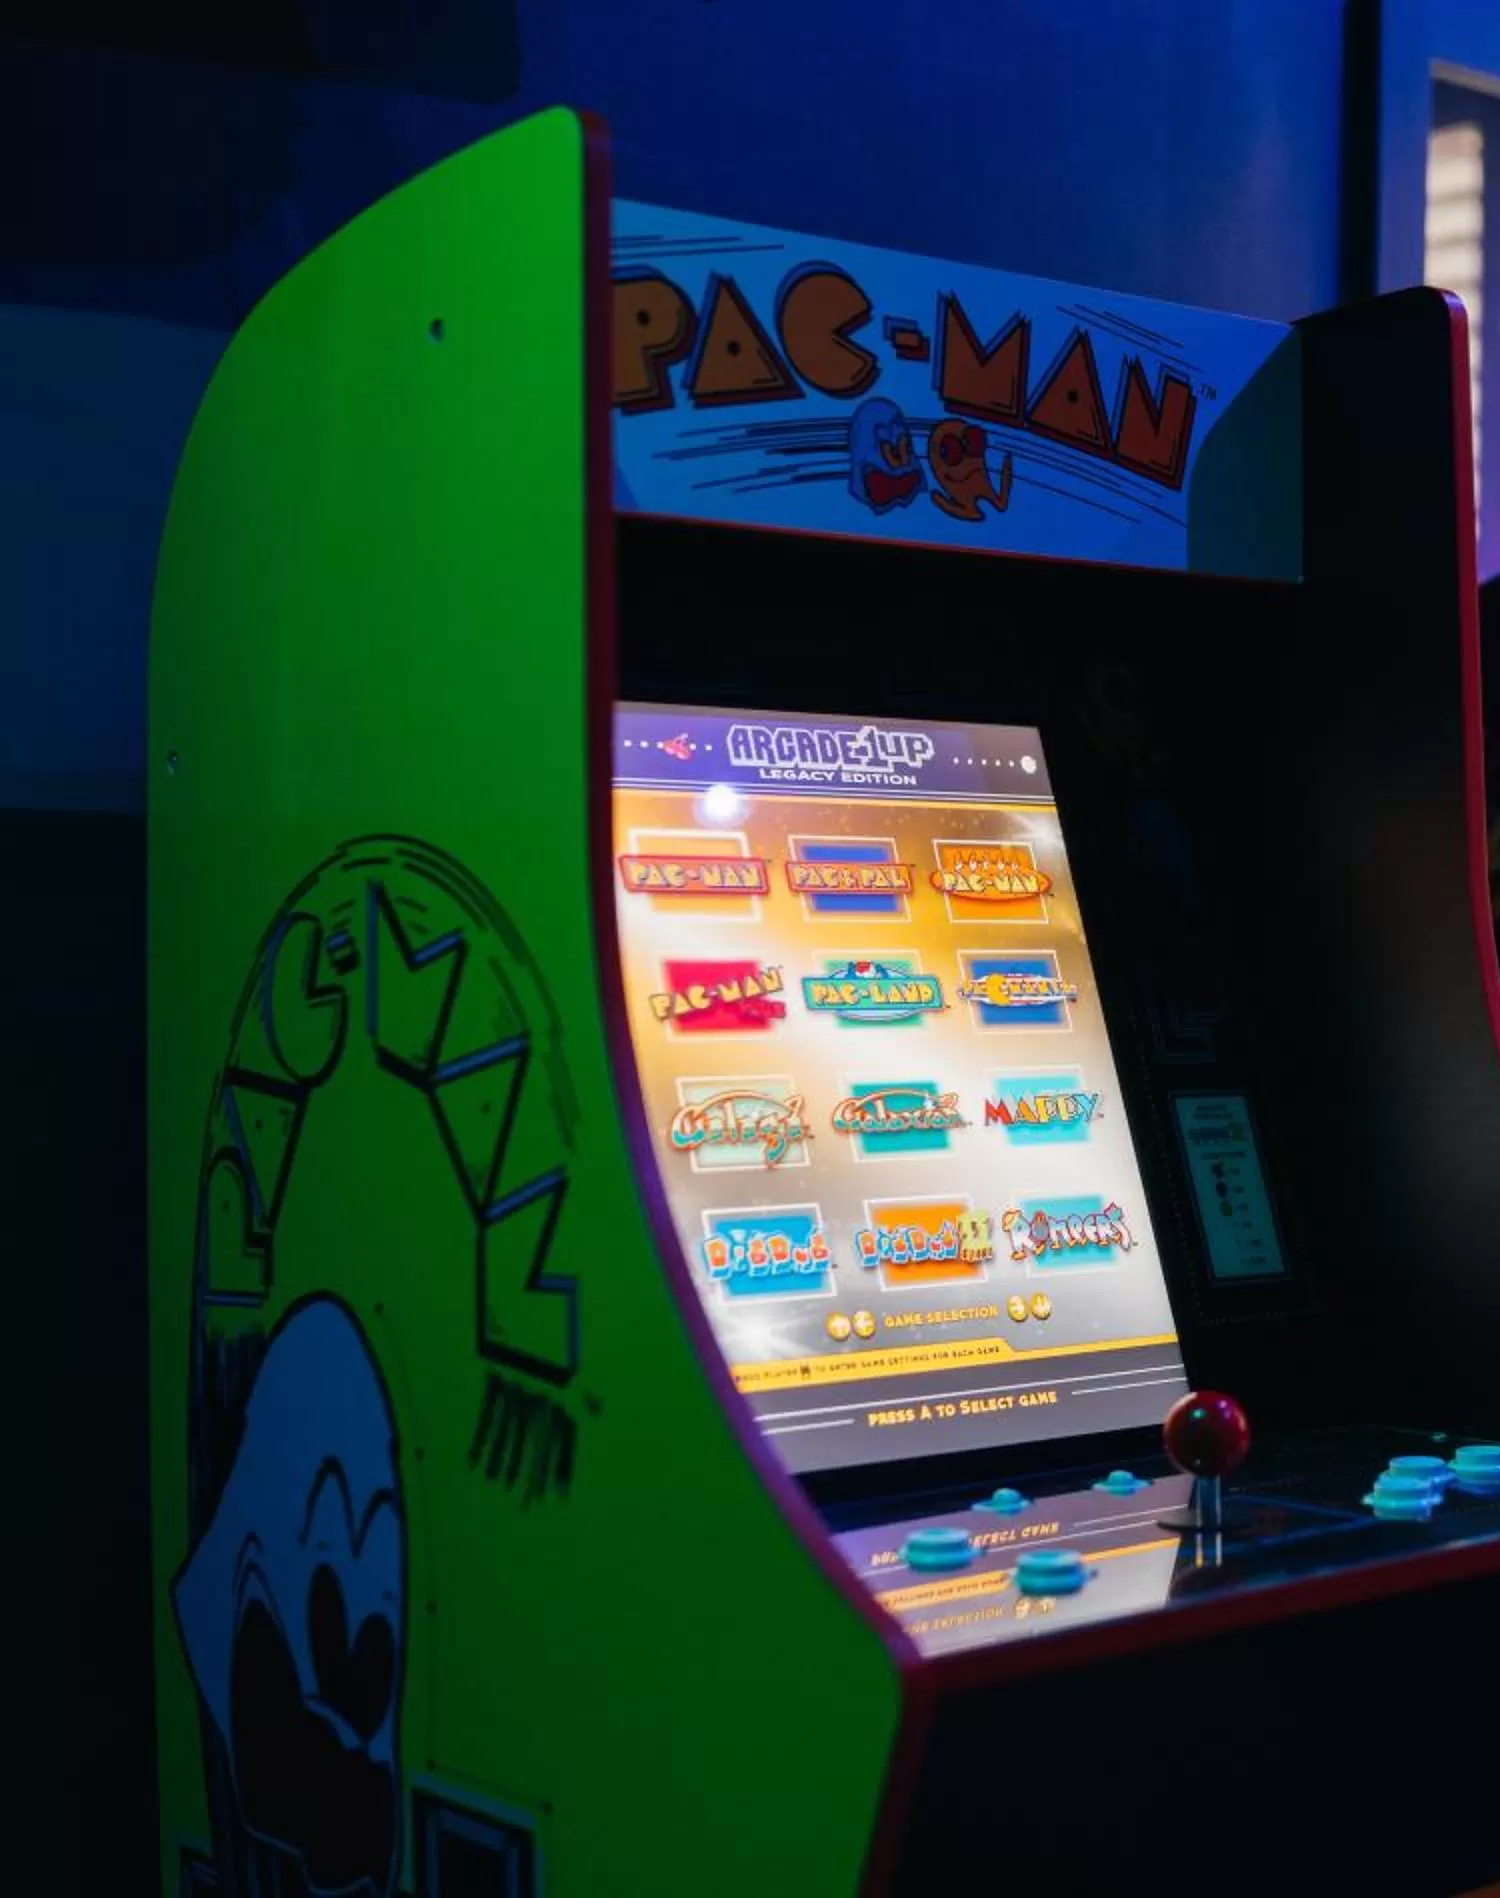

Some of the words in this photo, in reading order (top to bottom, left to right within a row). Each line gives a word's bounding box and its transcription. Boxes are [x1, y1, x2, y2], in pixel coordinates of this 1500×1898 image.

[610, 262, 1198, 493] PAC-MAN
[759, 767, 835, 783] LEGACY
[841, 771, 918, 786] EDITION
[629, 861, 764, 889] PAC-MAN
[943, 872, 1042, 893] PAC-MAN
[649, 965, 785, 1022] PAC-MAN
[811, 981, 935, 1006] PAC-LAND
[984, 1091, 1100, 1127] MAPPY
[884, 1311, 923, 1329] GAME
[927, 1303, 999, 1323] SELECTION
[867, 1407, 916, 1427] PRESS
[920, 1404, 933, 1420] A
[936, 1402, 957, 1418] TO
[960, 1396, 1014, 1415] SELECT
[1019, 1391, 1058, 1407] GAME
